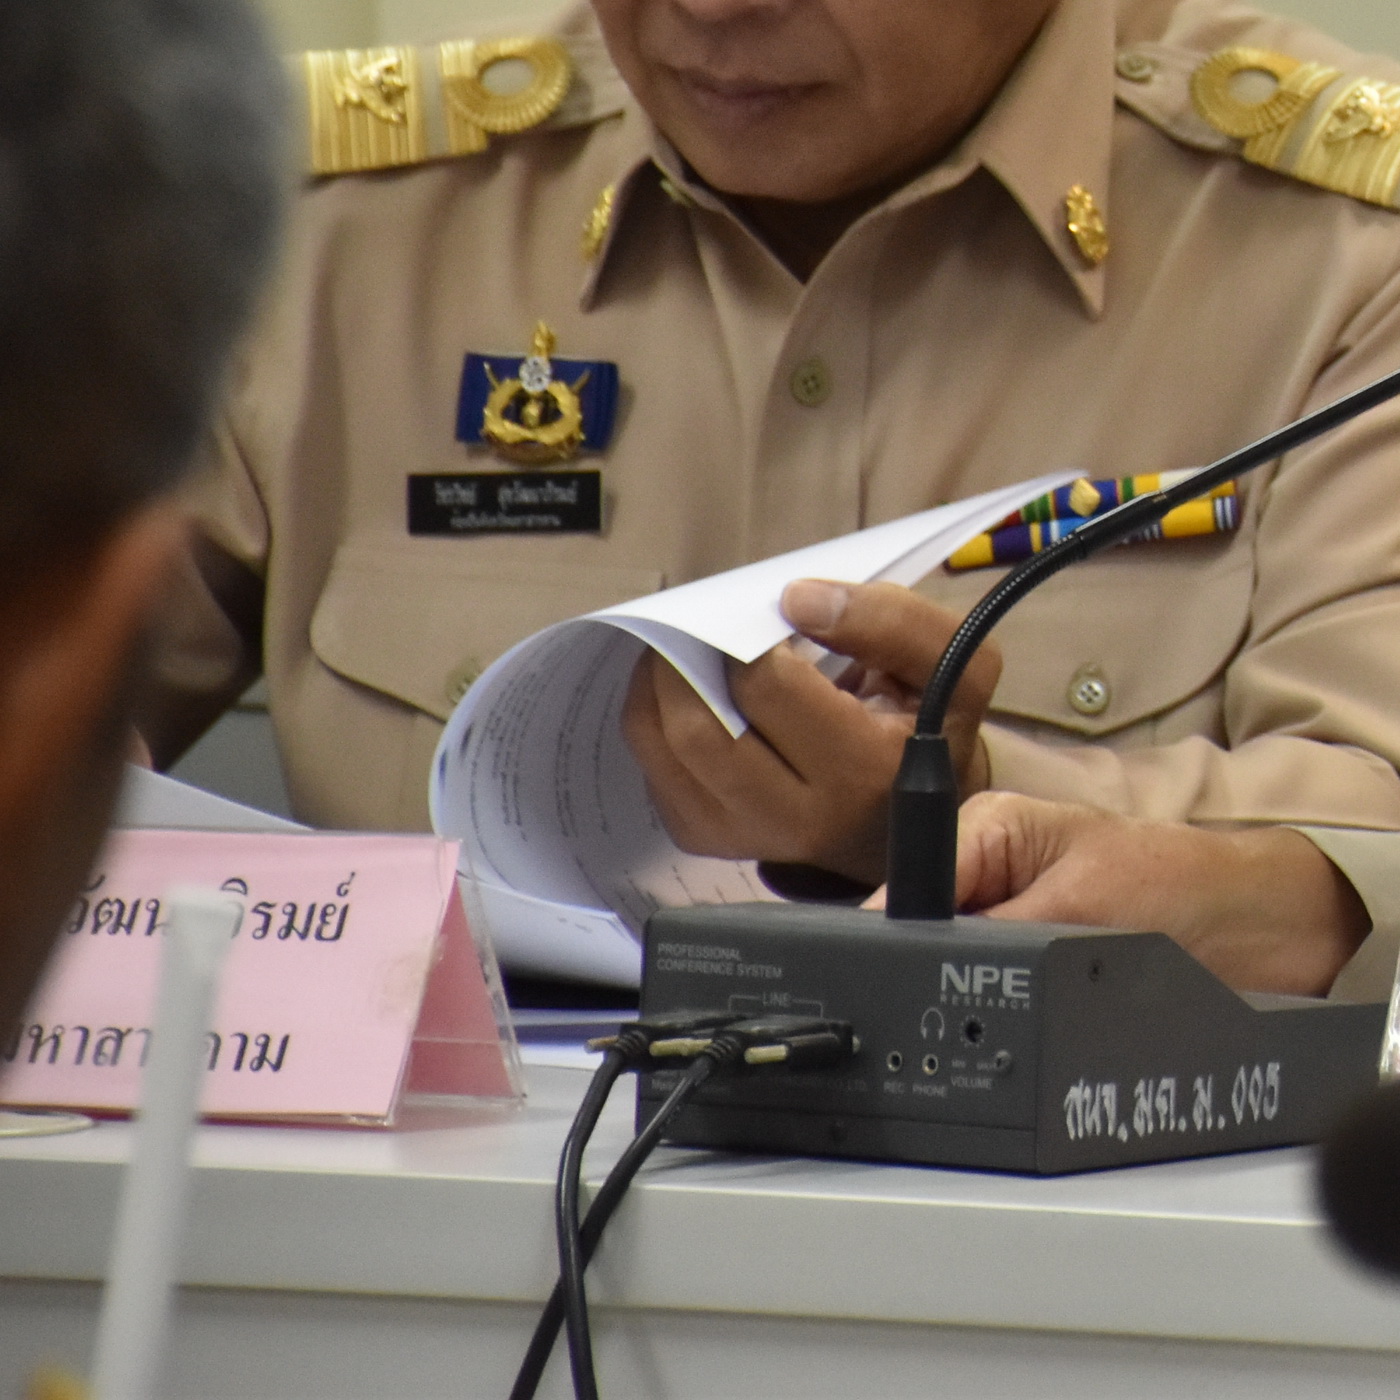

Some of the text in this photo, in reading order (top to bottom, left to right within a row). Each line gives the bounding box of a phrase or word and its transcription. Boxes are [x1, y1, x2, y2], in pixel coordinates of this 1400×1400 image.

[657, 942, 743, 962] PROFESSIONAL
[656, 958, 784, 980] CONFERENCE SYSTEM
[940, 962, 1032, 999] NPE
[762, 991, 793, 1008] LINE
[939, 993, 1032, 1011] RESEARCH
[911, 1083, 947, 1099] PHONE
[950, 1075, 994, 1091] VOLUME
